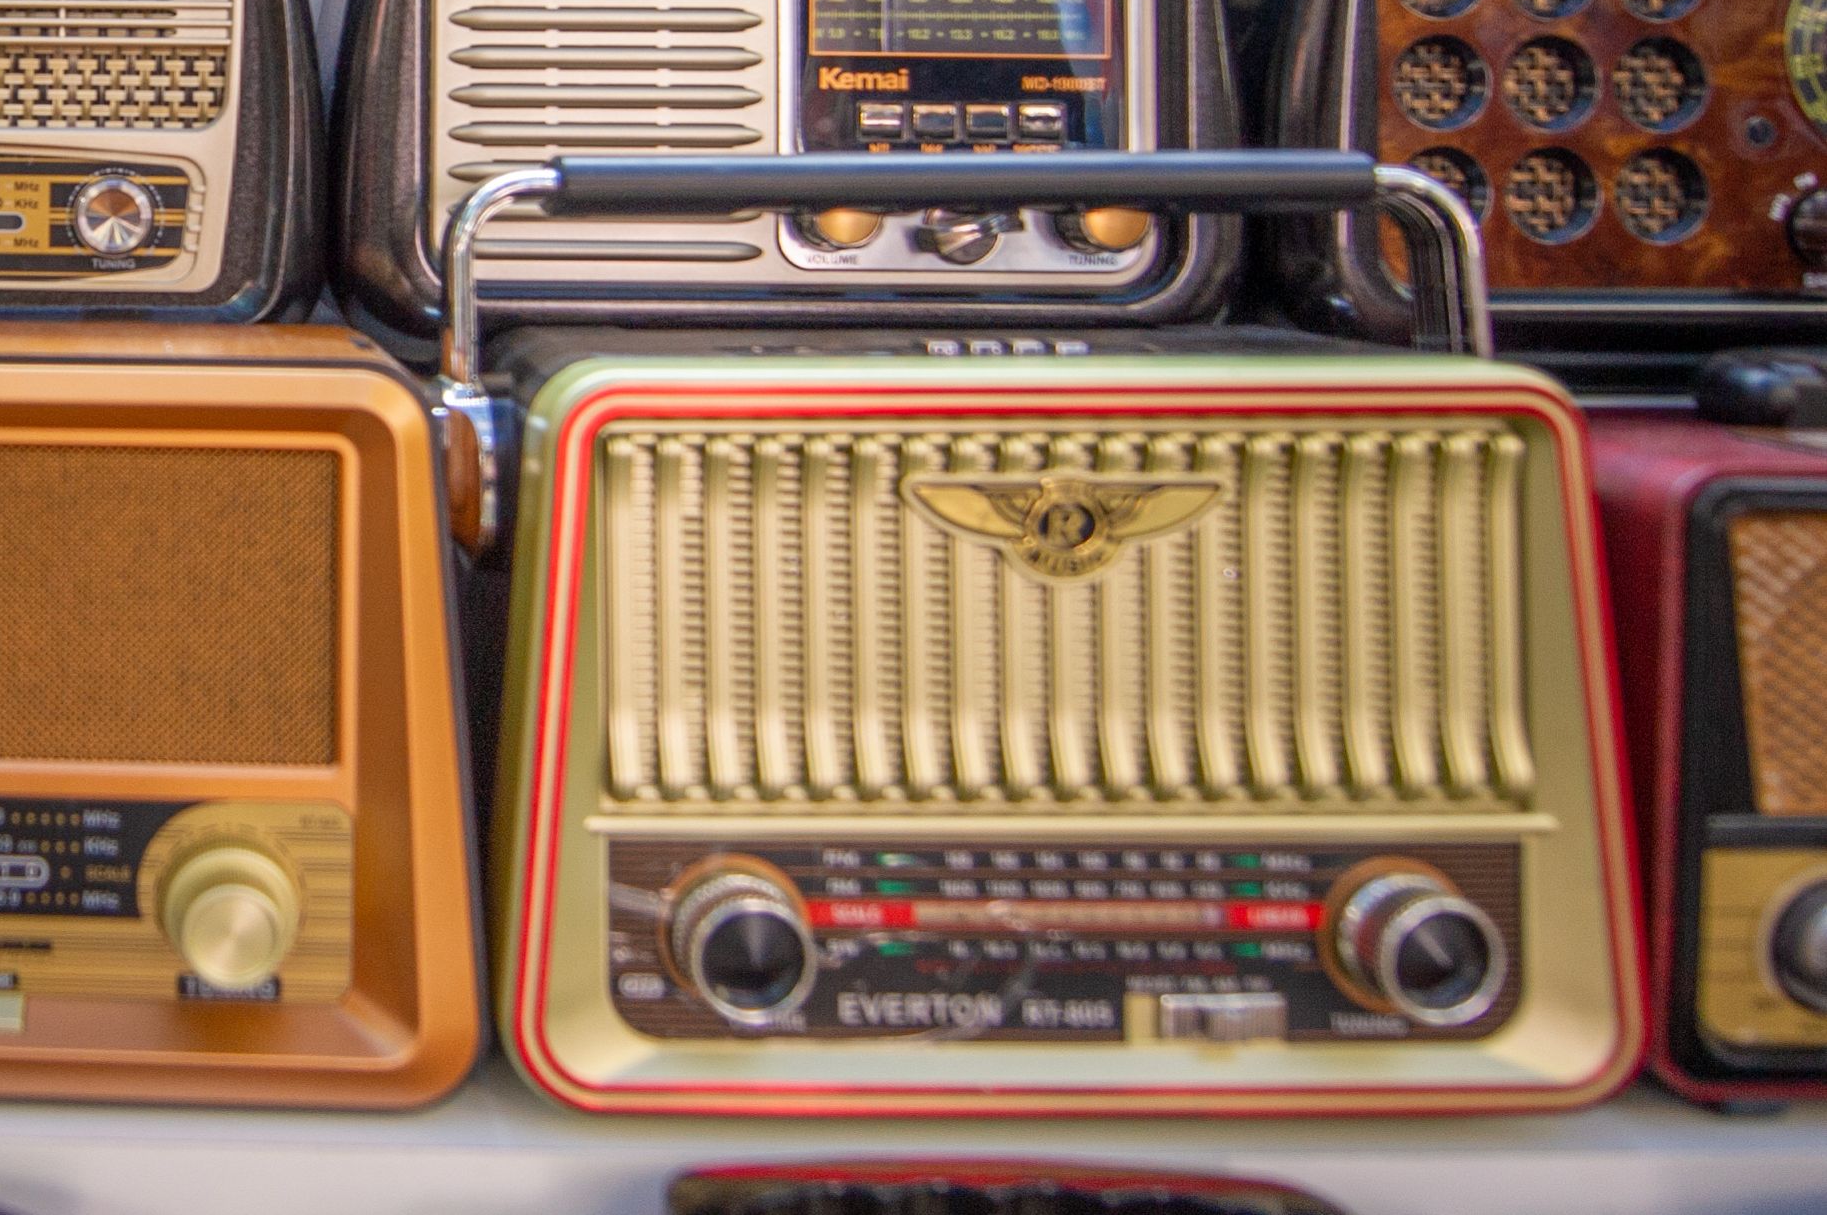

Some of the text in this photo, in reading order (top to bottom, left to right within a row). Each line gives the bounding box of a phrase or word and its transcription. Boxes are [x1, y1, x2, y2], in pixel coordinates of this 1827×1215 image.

[819, 67, 909, 90] Kemai
[14, 183, 39, 192] MHz
[14, 199, 38, 208] KHz
[13, 238, 39, 247] MHz
[92, 258, 136, 270] TUNING
[837, 992, 1004, 1027] EVERTON
